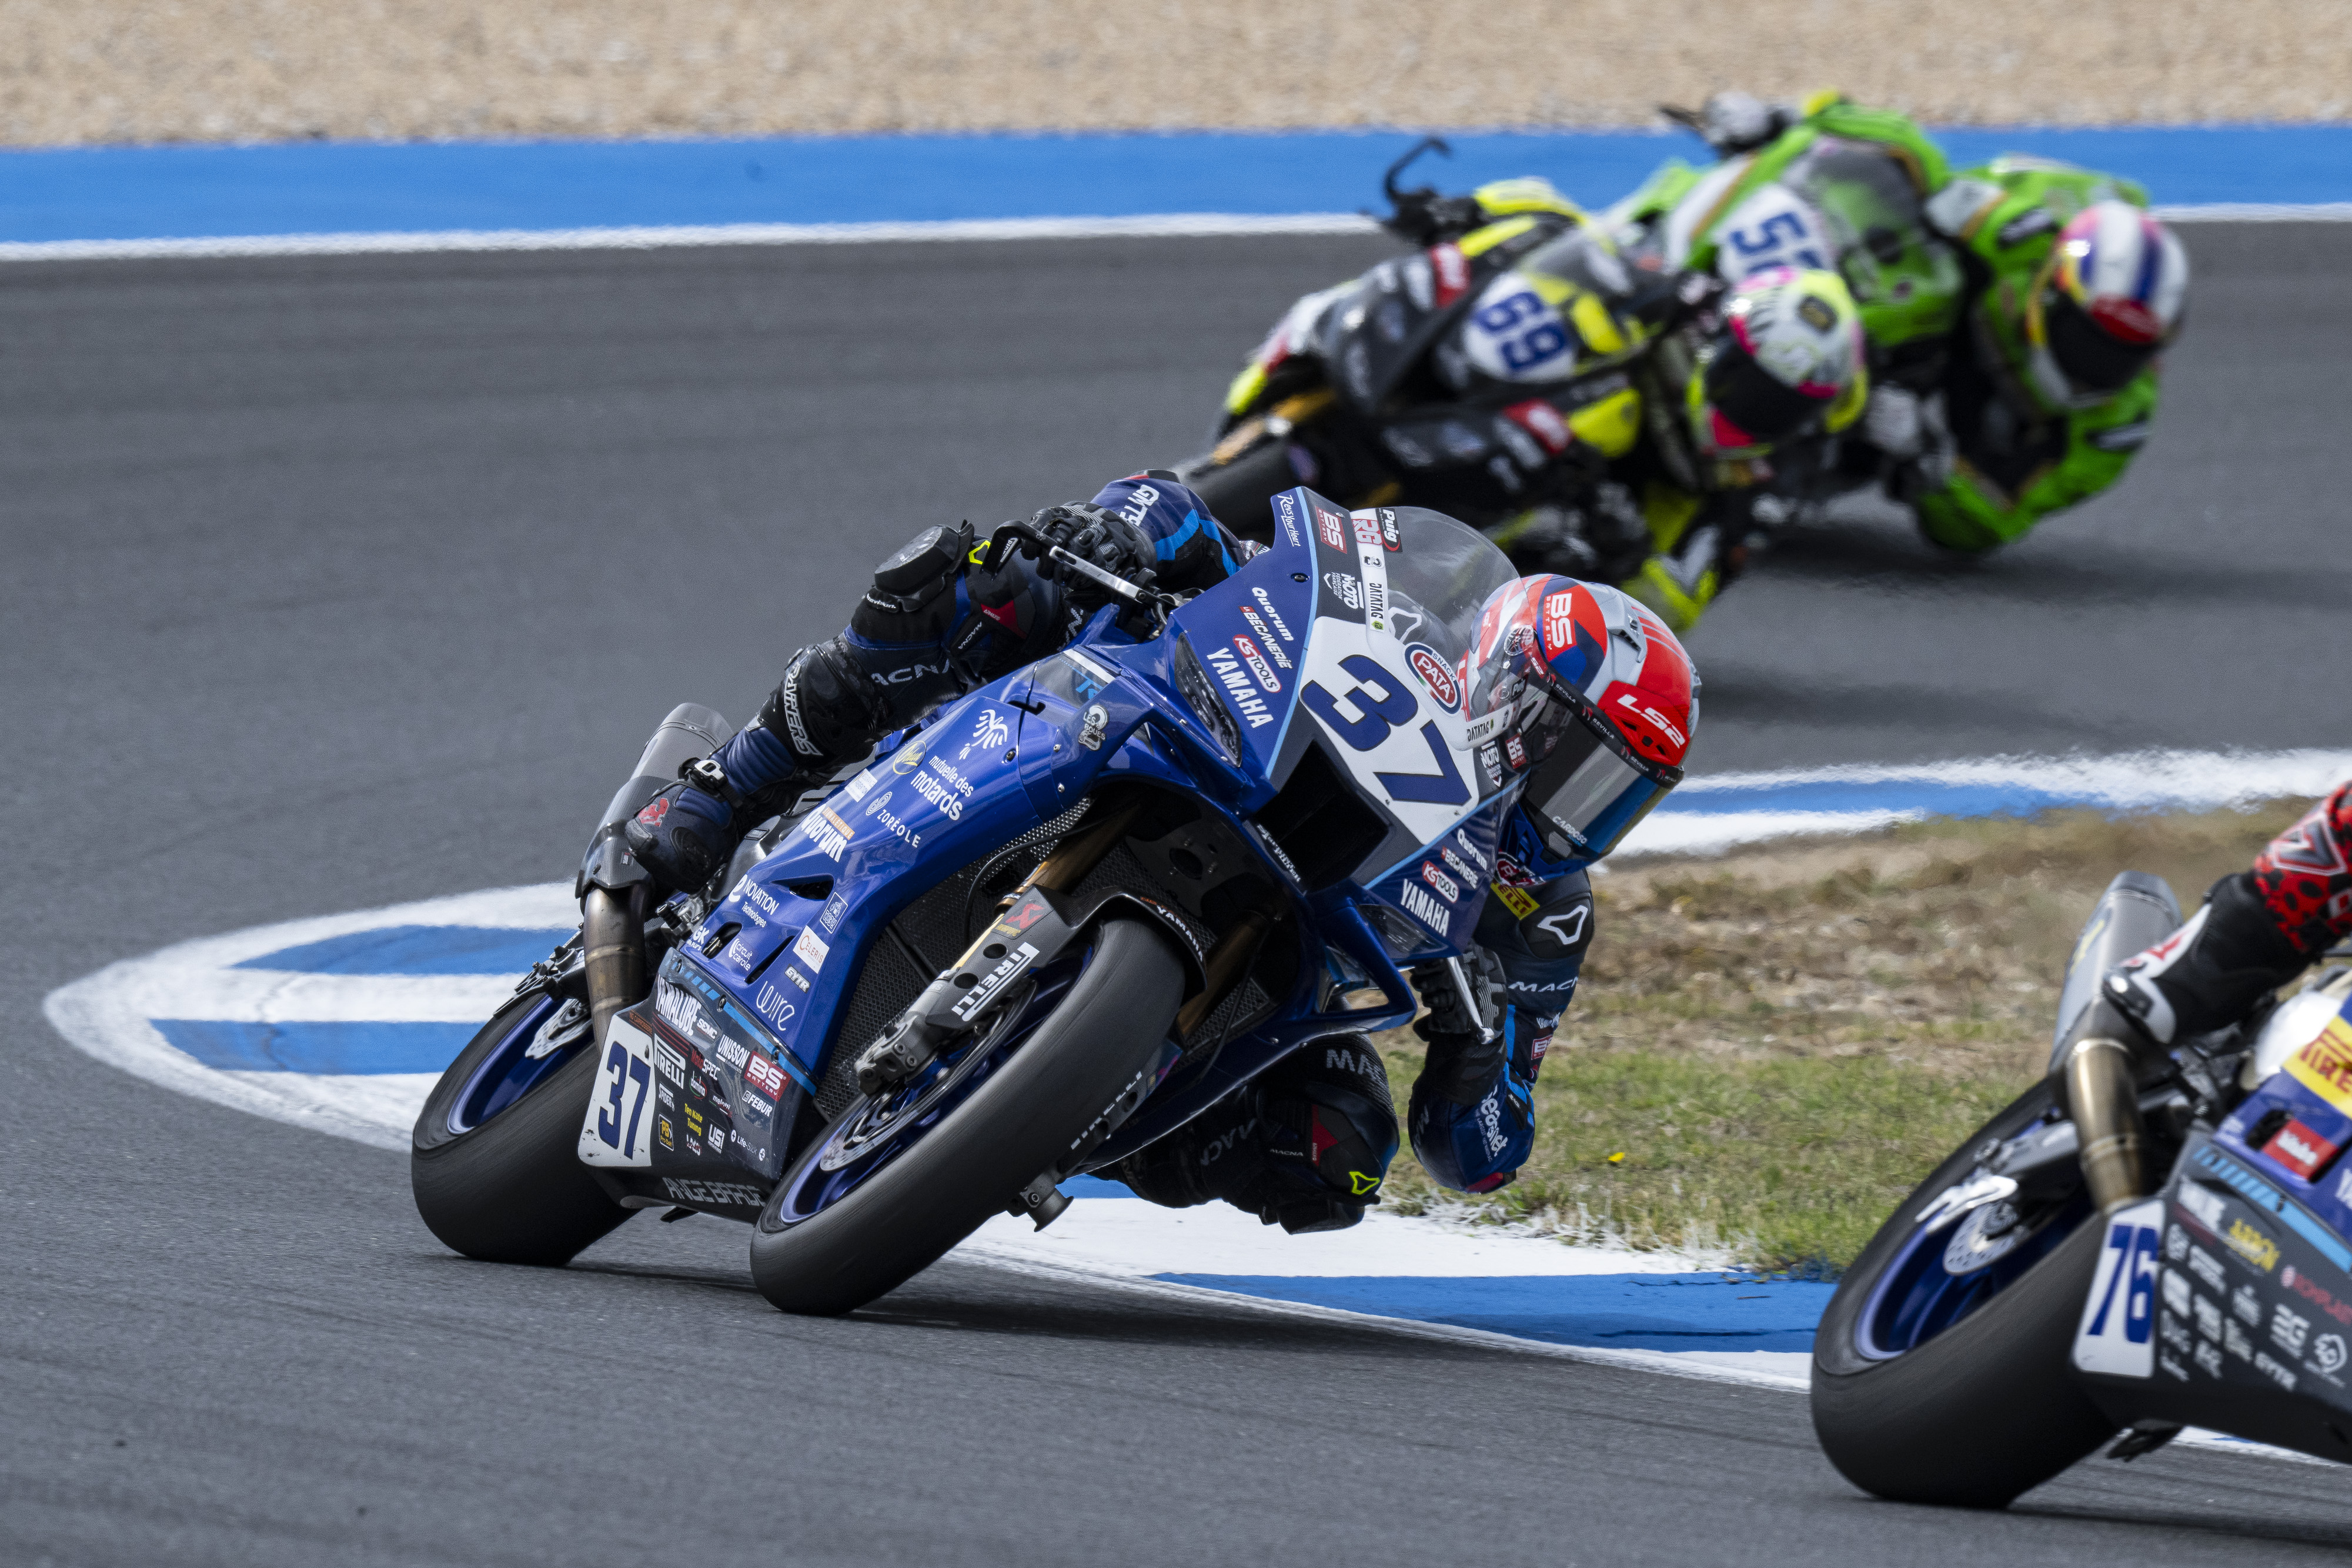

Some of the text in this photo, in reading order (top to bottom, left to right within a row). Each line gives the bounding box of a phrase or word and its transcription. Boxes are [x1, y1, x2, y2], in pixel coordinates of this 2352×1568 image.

[1322, 511, 1344, 551] BS
[1383, 509, 1397, 543] Puig
[1252, 587, 1294, 641] Quorum
[1545, 595, 1553, 650] BATTERY
[1551, 593, 1572, 648] BS
[1235, 637, 1279, 689] KS TOOLS
[1417, 656, 1452, 700] PATA
[1432, 653, 1455, 681] SNACK
[1207, 647, 1274, 728] YAMAHA
[1555, 684, 1576, 704] SEVILLA
[1300, 654, 1472, 806] 37
[1592, 718, 1615, 739] SEVILLA
[1617, 694, 1686, 749] LS2
[928, 755, 974, 798] mutuelle des
[911, 770, 963, 821] motards
[800, 803, 847, 862] Quorum
[877, 809, 921, 848] ZORÉOLE
[1552, 815, 1588, 844] CARDOSO
[1457, 828, 1487, 871] Quorum
[1437, 874, 1456, 899] TOOLS
[741, 901, 767, 928] Technologies
[1401, 878, 1450, 937] YAMAHA
[736, 938, 754, 959] circuit
[800, 935, 824, 964] CELERIS
[1157, 906, 1203, 962] YAMAHA
[733, 952, 751, 971] carole
[786, 966, 810, 992] GYTR
[952, 942, 1040, 1022] PIRELLI
[697, 1018, 717, 1039] SEMC
[654, 1033, 686, 1089] PIRELLI
[717, 1034, 750, 1069] UNISSON
[747, 1072, 777, 1096] BATTERY
[749, 1055, 784, 1091] BS
[598, 1041, 651, 1160] 37
[692, 1108, 703, 1123] Kate
[713, 1095, 731, 1110] melotti
[749, 1094, 773, 1117] FEBUR
[687, 1118, 702, 1137] Tuning
[1269, 1148, 1304, 1158] MACNA
[2086, 1223, 2159, 1345] 76
